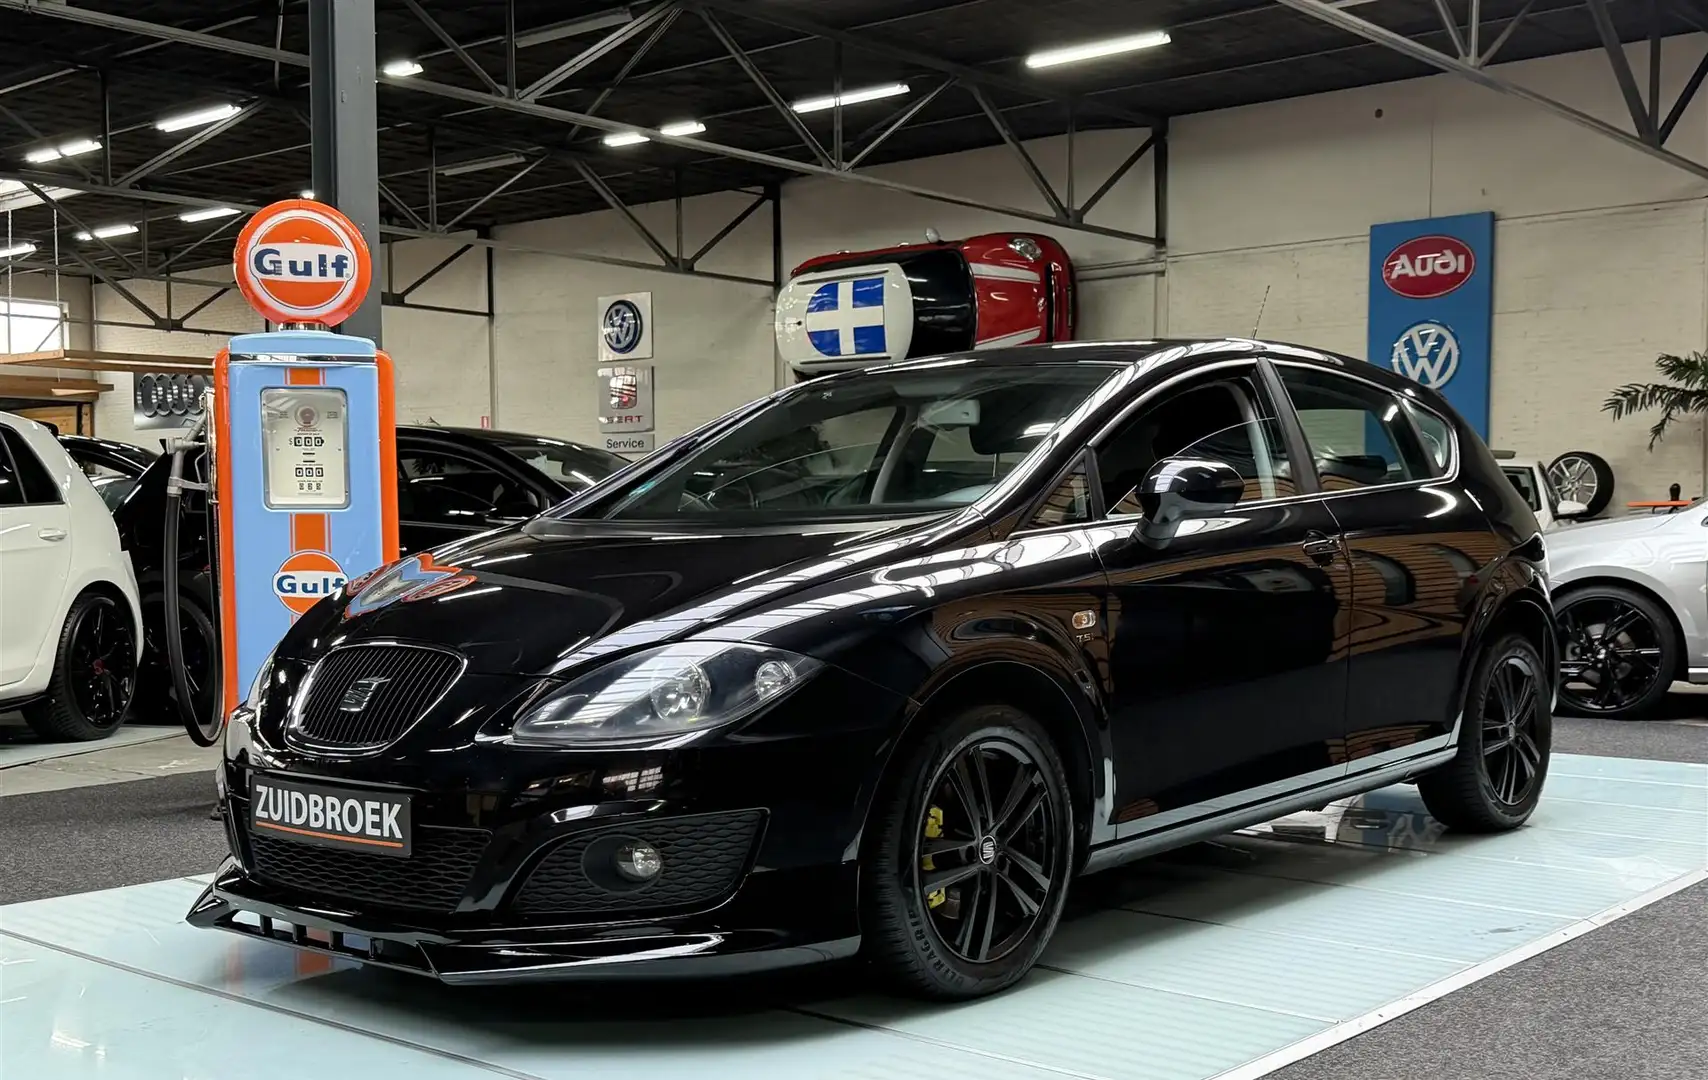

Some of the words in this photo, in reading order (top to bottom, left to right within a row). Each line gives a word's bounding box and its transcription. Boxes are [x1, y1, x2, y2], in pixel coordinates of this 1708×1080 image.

[254, 248, 349, 278] Gulf
[1391, 250, 1465, 280] Audi
[606, 438, 644, 450] Service
[276, 574, 345, 594] Gulf
[255, 784, 403, 839] ZUIDBROEK
